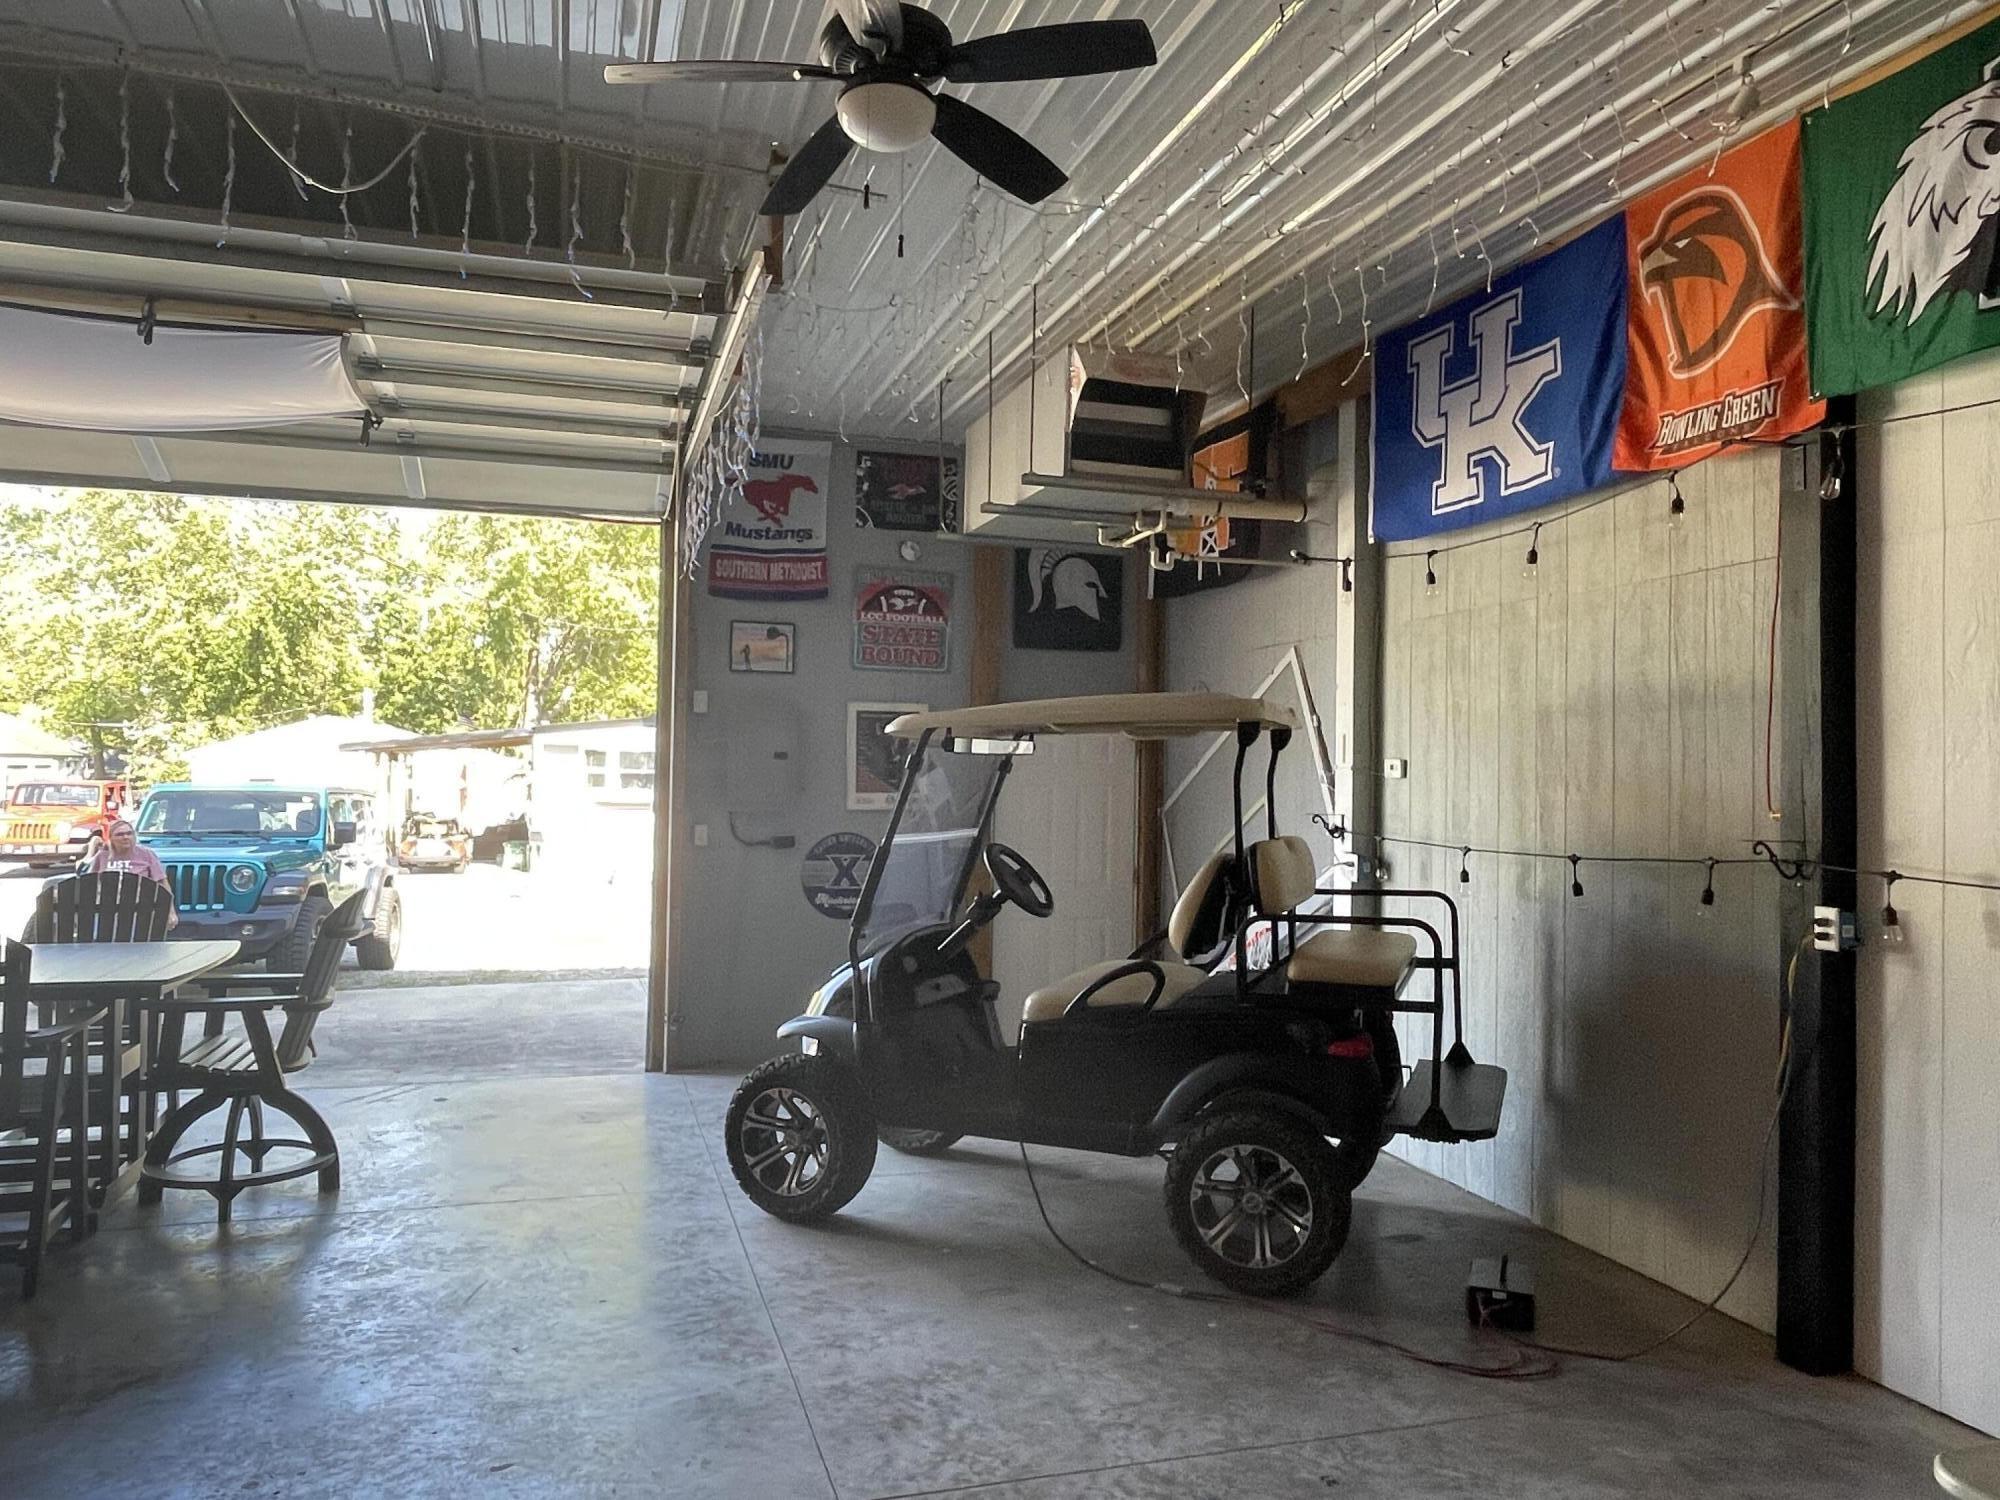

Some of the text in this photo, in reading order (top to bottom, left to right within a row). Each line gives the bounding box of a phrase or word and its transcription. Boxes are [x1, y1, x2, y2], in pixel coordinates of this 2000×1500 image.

[1407, 287, 1562, 514] UK
[1657, 385, 1777, 446] BOWLING GREEN
[749, 452, 794, 470] SMU
[725, 522, 814, 542] Mustangs
[715, 558, 823, 581] SOUTHERN METHODIST
[861, 612, 944, 624] LCC FOOTBALL
[862, 626, 940, 644] STATE
[860, 646, 940, 665] BOUND
